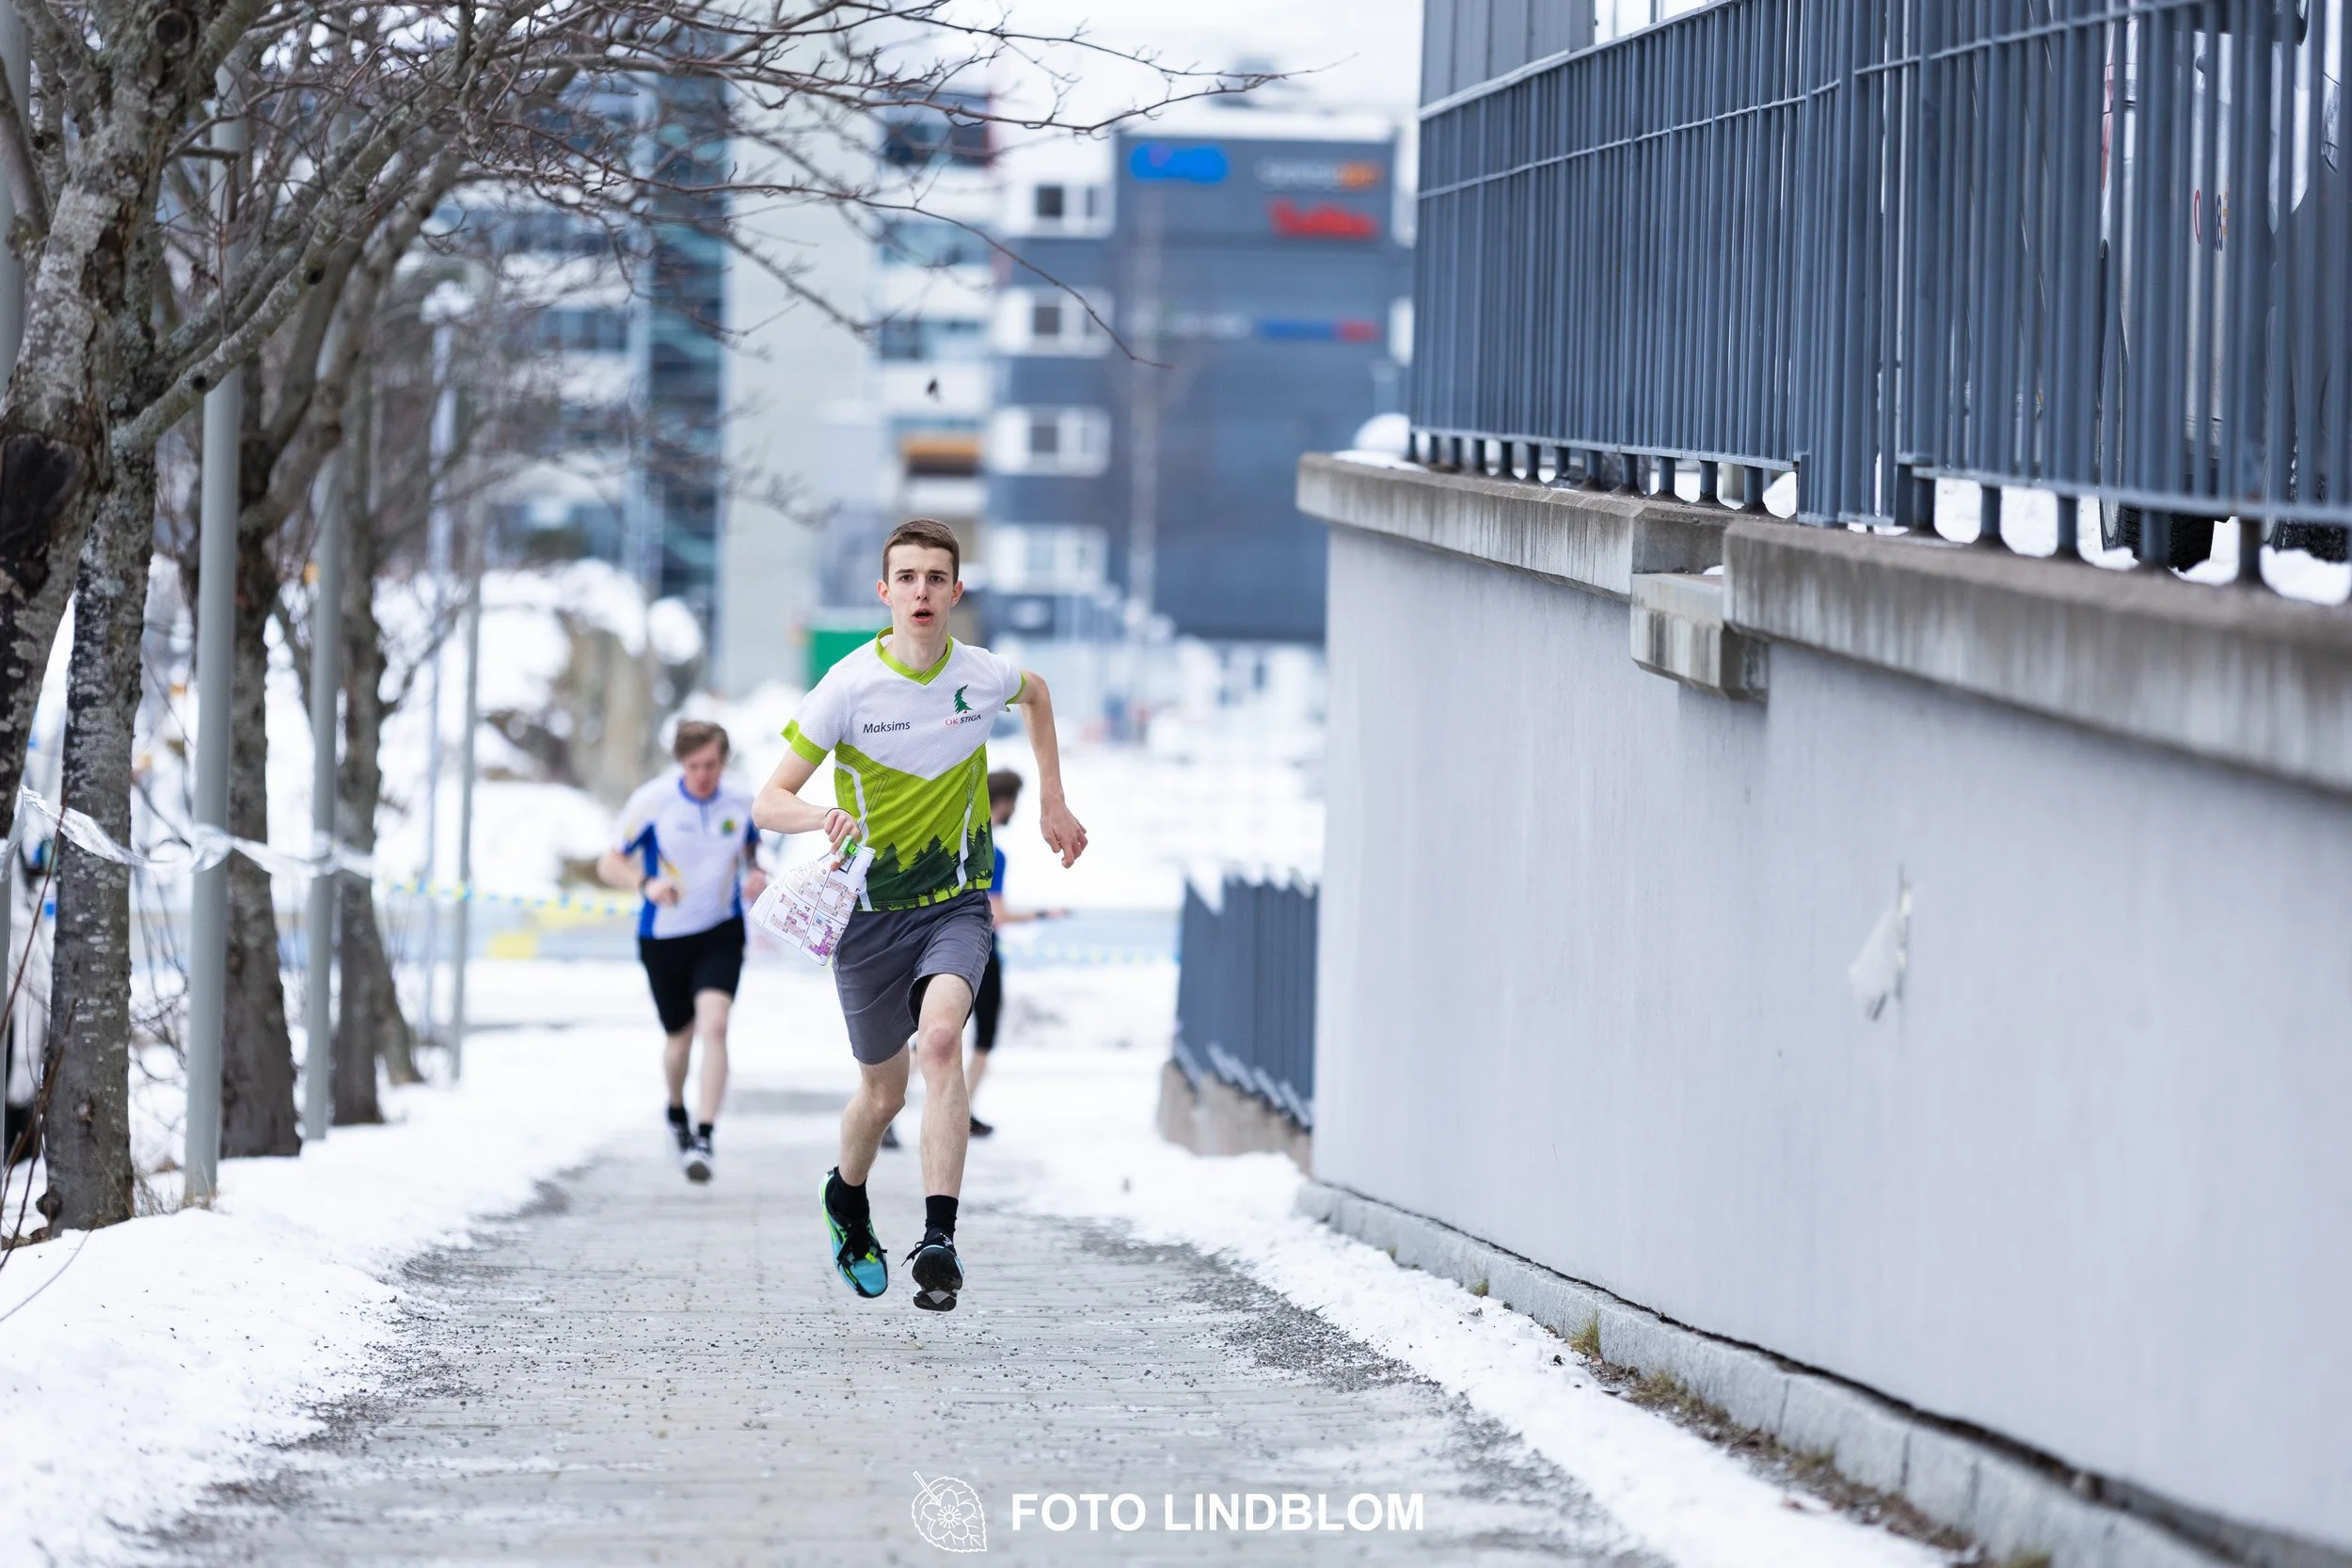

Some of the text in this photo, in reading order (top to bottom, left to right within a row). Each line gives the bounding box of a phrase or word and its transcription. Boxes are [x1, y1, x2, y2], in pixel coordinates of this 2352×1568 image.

[945, 714, 981, 727] OK STIGA
[863, 721, 911, 734] Maksims
